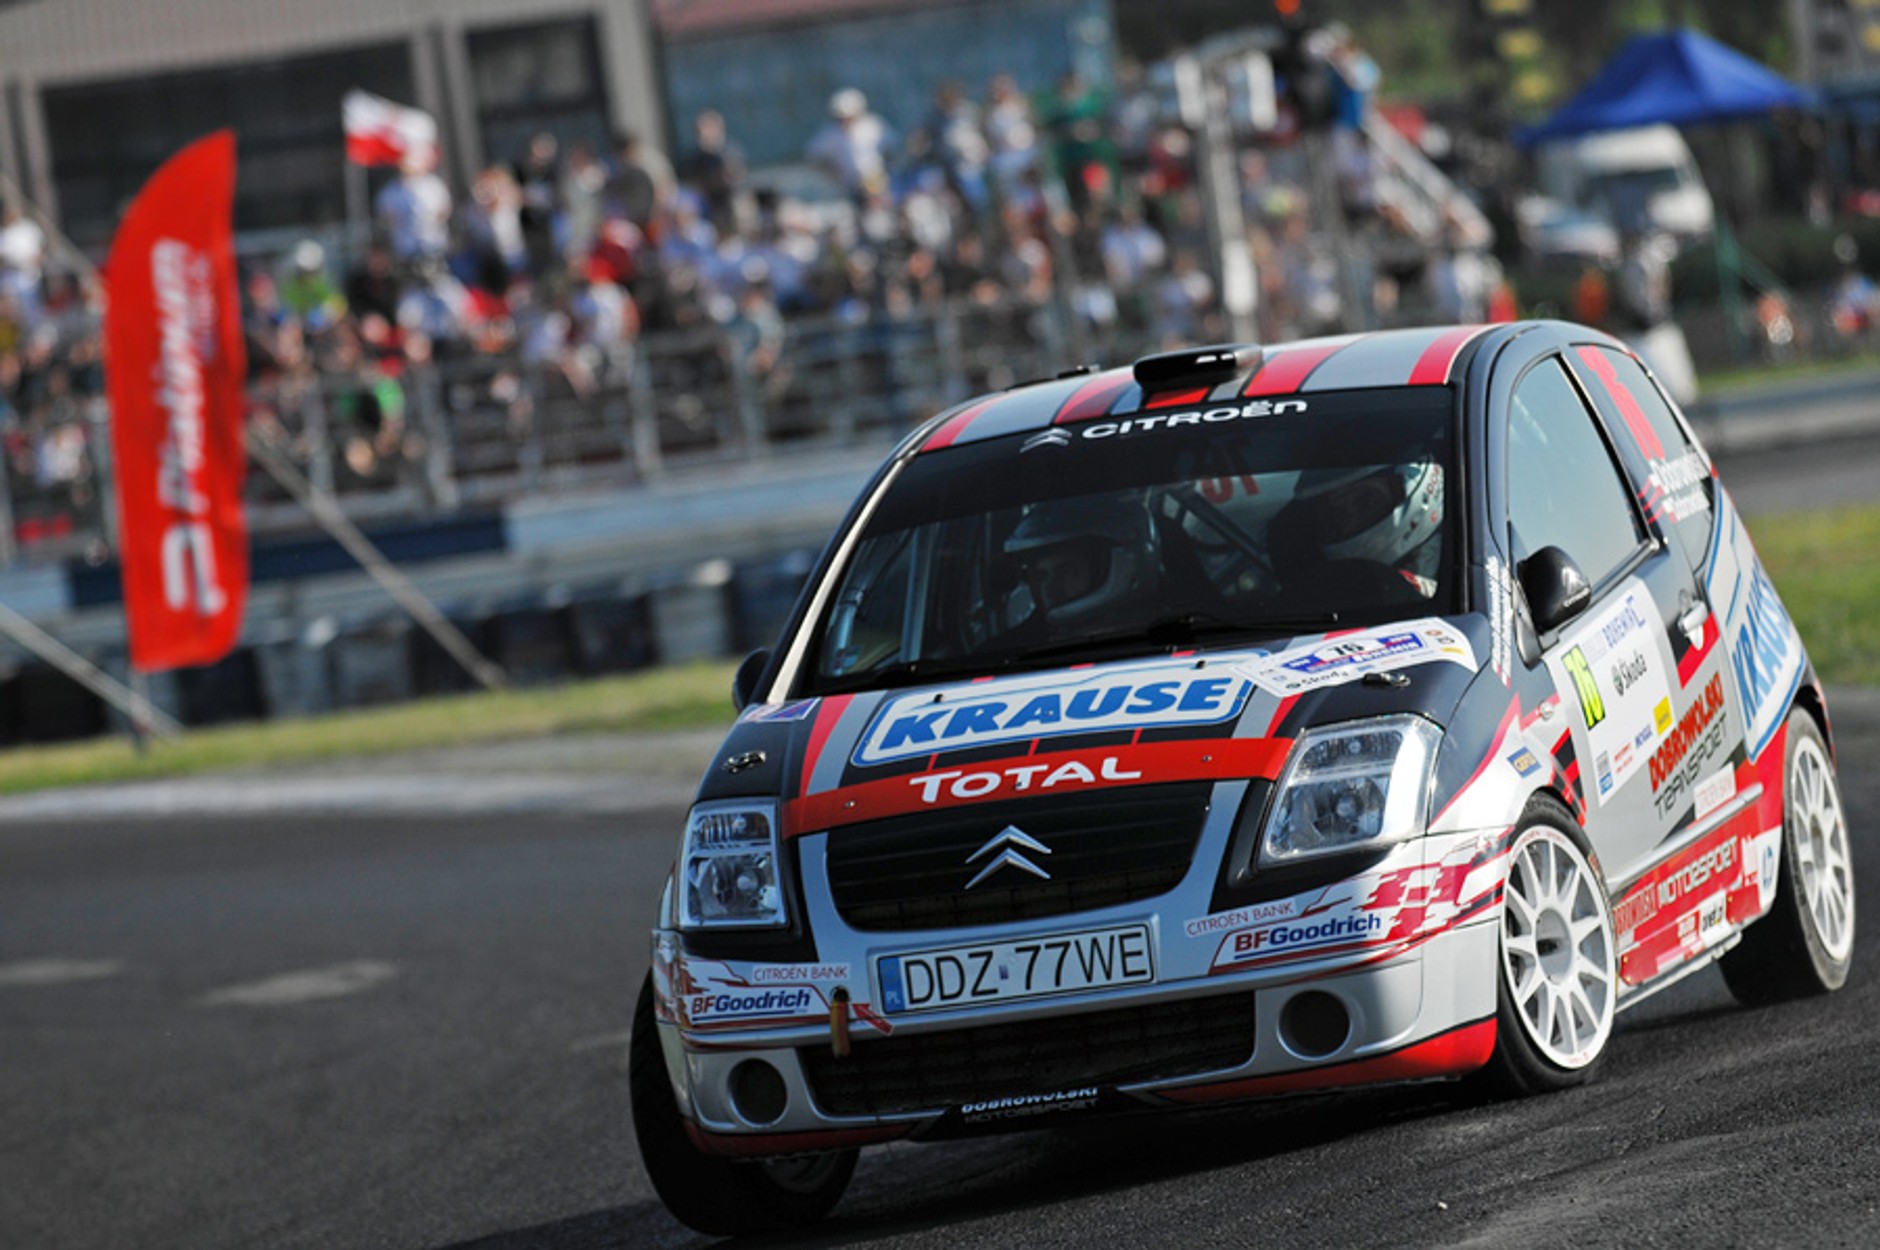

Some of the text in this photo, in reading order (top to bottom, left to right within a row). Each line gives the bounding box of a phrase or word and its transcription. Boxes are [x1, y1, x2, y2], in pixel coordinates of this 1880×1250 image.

[878, 676, 1232, 751] KRAUSE
[1649, 671, 1725, 793] DOBROWOLSKI
[910, 757, 1142, 803] TOTAL
[1252, 901, 1293, 921] BANK
[1234, 913, 1381, 953] BFGoodrich
[811, 965, 848, 980] BANK
[904, 931, 1149, 1005] DDZ 77WE
[691, 988, 811, 1015] BFGoodrich
